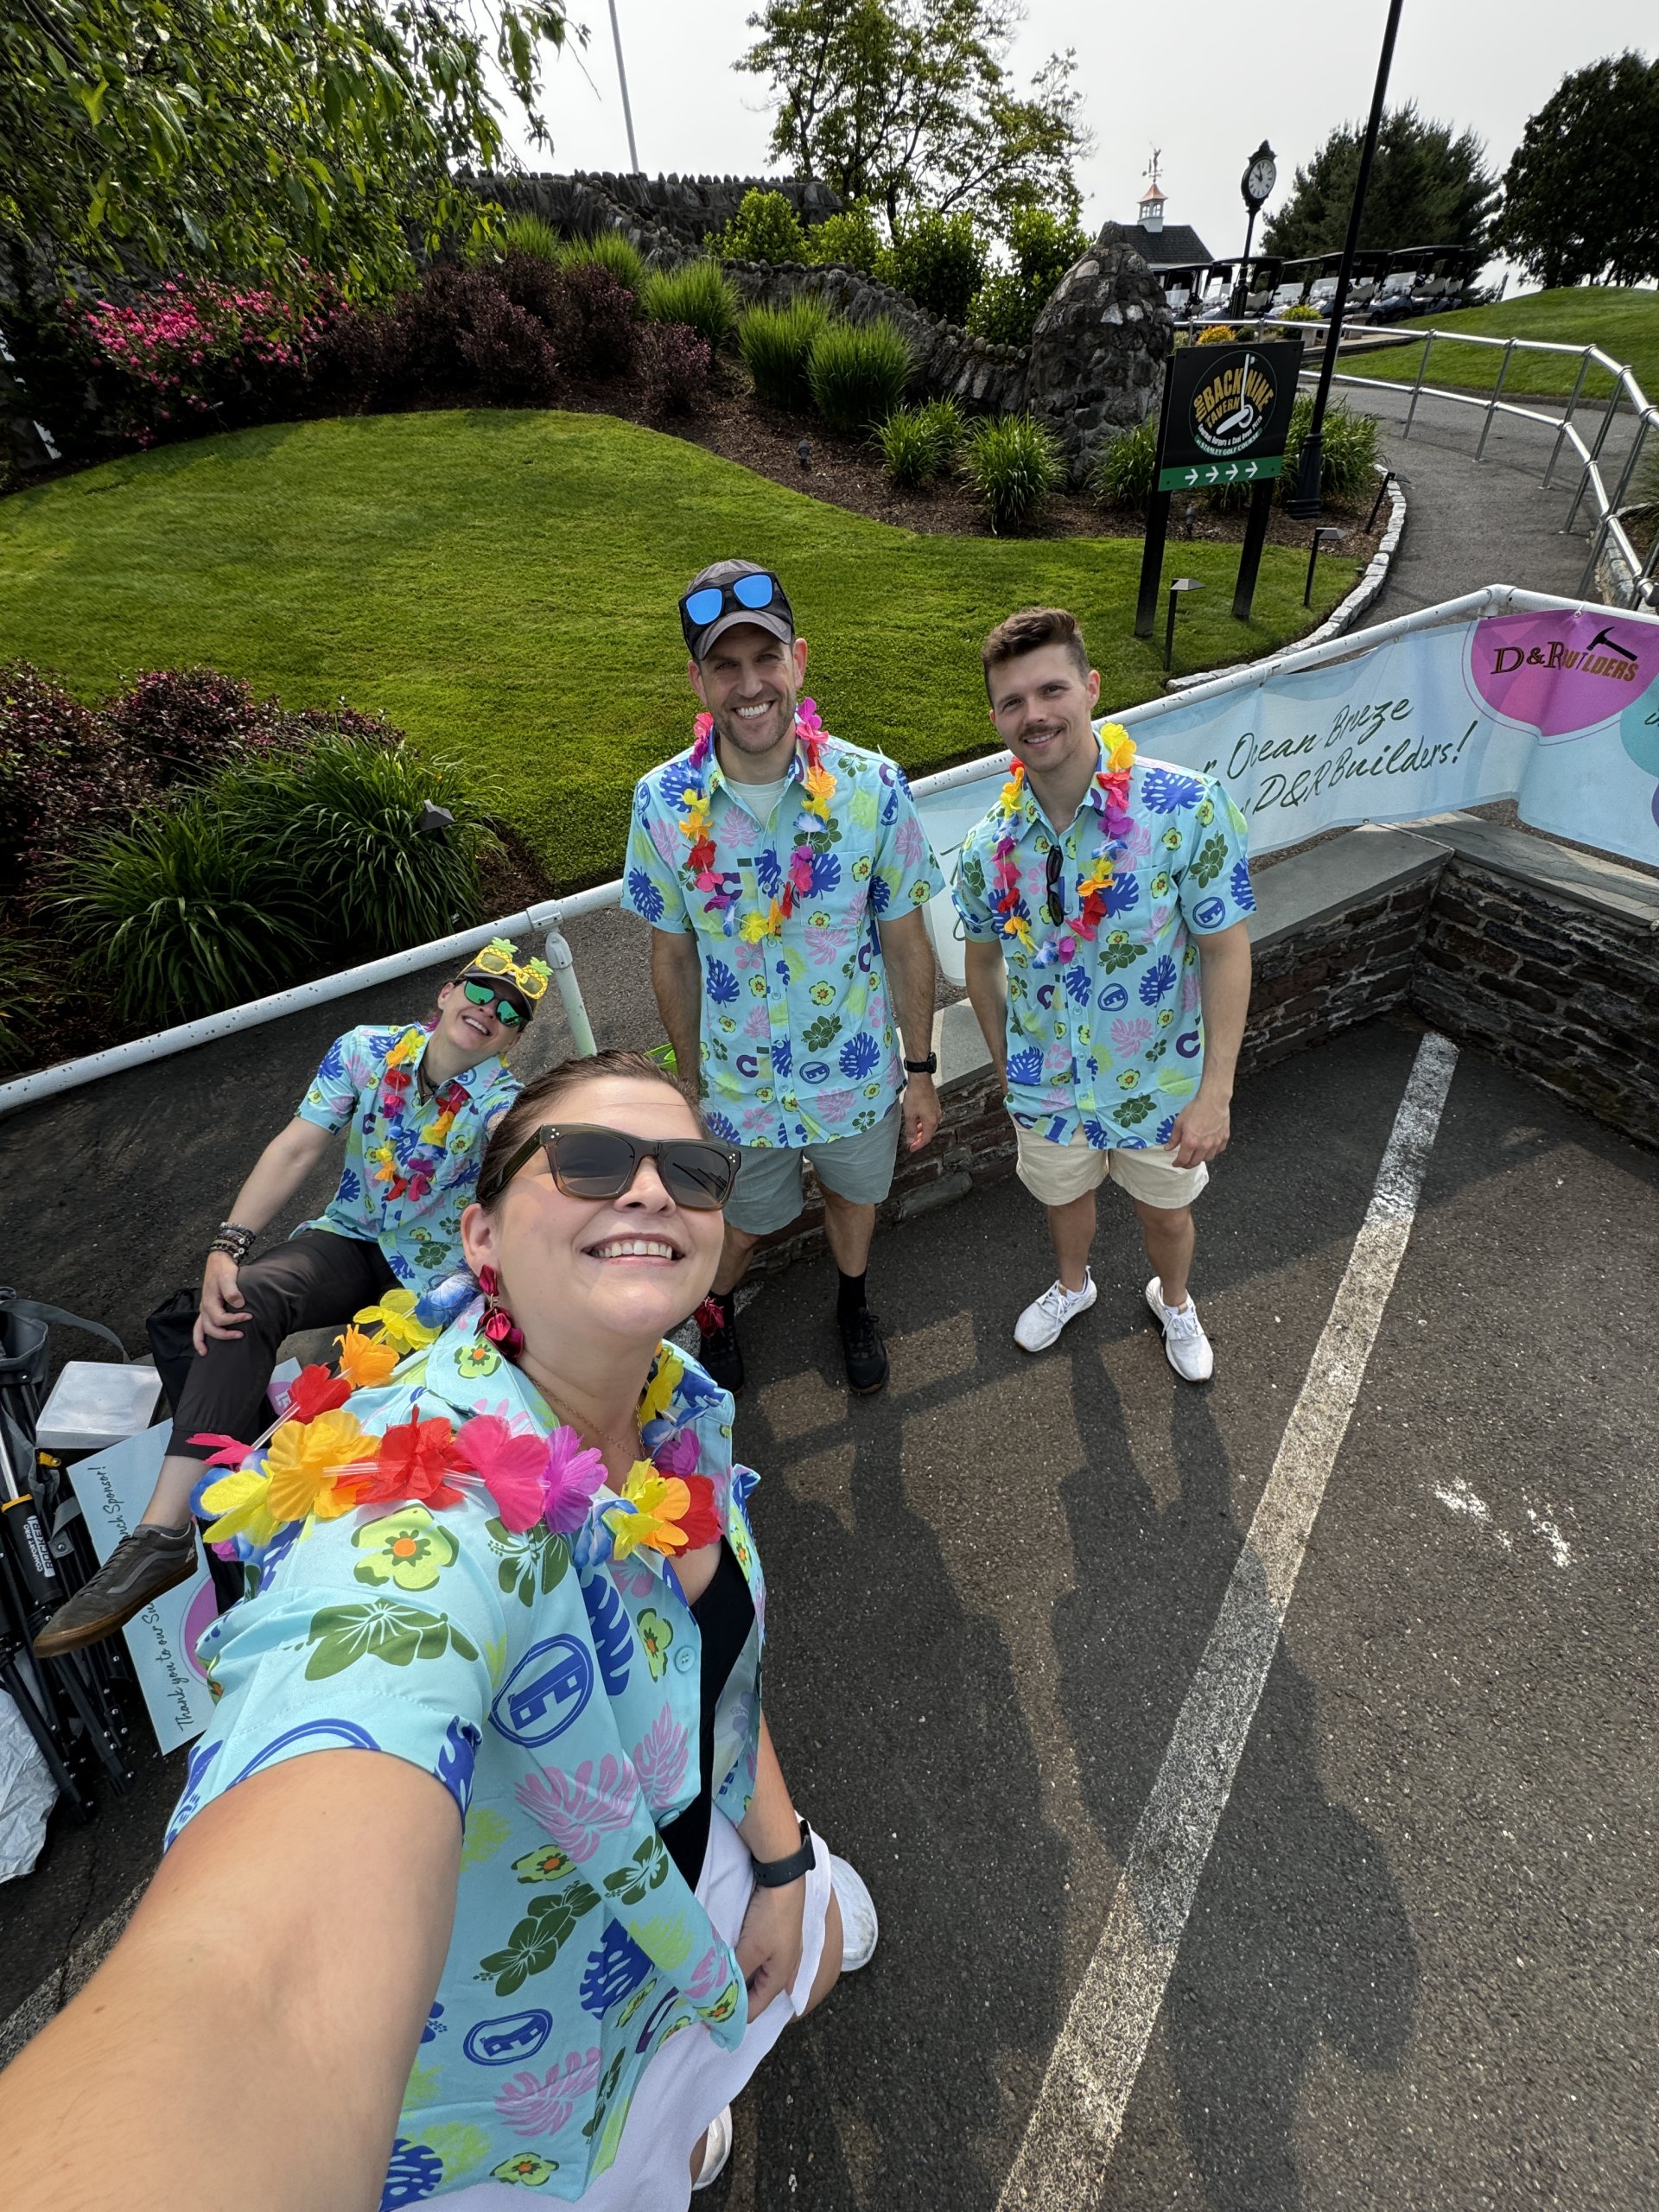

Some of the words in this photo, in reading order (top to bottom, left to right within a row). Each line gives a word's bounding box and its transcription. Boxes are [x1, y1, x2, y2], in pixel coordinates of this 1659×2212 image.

[1203, 367, 1244, 413] BACK
[1244, 369, 1274, 413] NINE
[1205, 397, 1241, 429] TAVERN
[1200, 442, 1223, 455] STANLEY
[1223, 447, 1238, 456] GOLF
[1237, 431, 1260, 451] COURSE
[1491, 641, 1565, 675] D&R
[86, 1465, 124, 1515] Sponsor!
[23, 1523, 33, 1539] PRO
[32, 1522, 54, 1569] ROCKER
[28, 1540, 43, 1572] COMFORT
[152, 1625, 168, 1646] our
[156, 1648, 172, 1665] to
[166, 1662, 190, 1685] you
[167, 1686, 194, 1732] Thank
